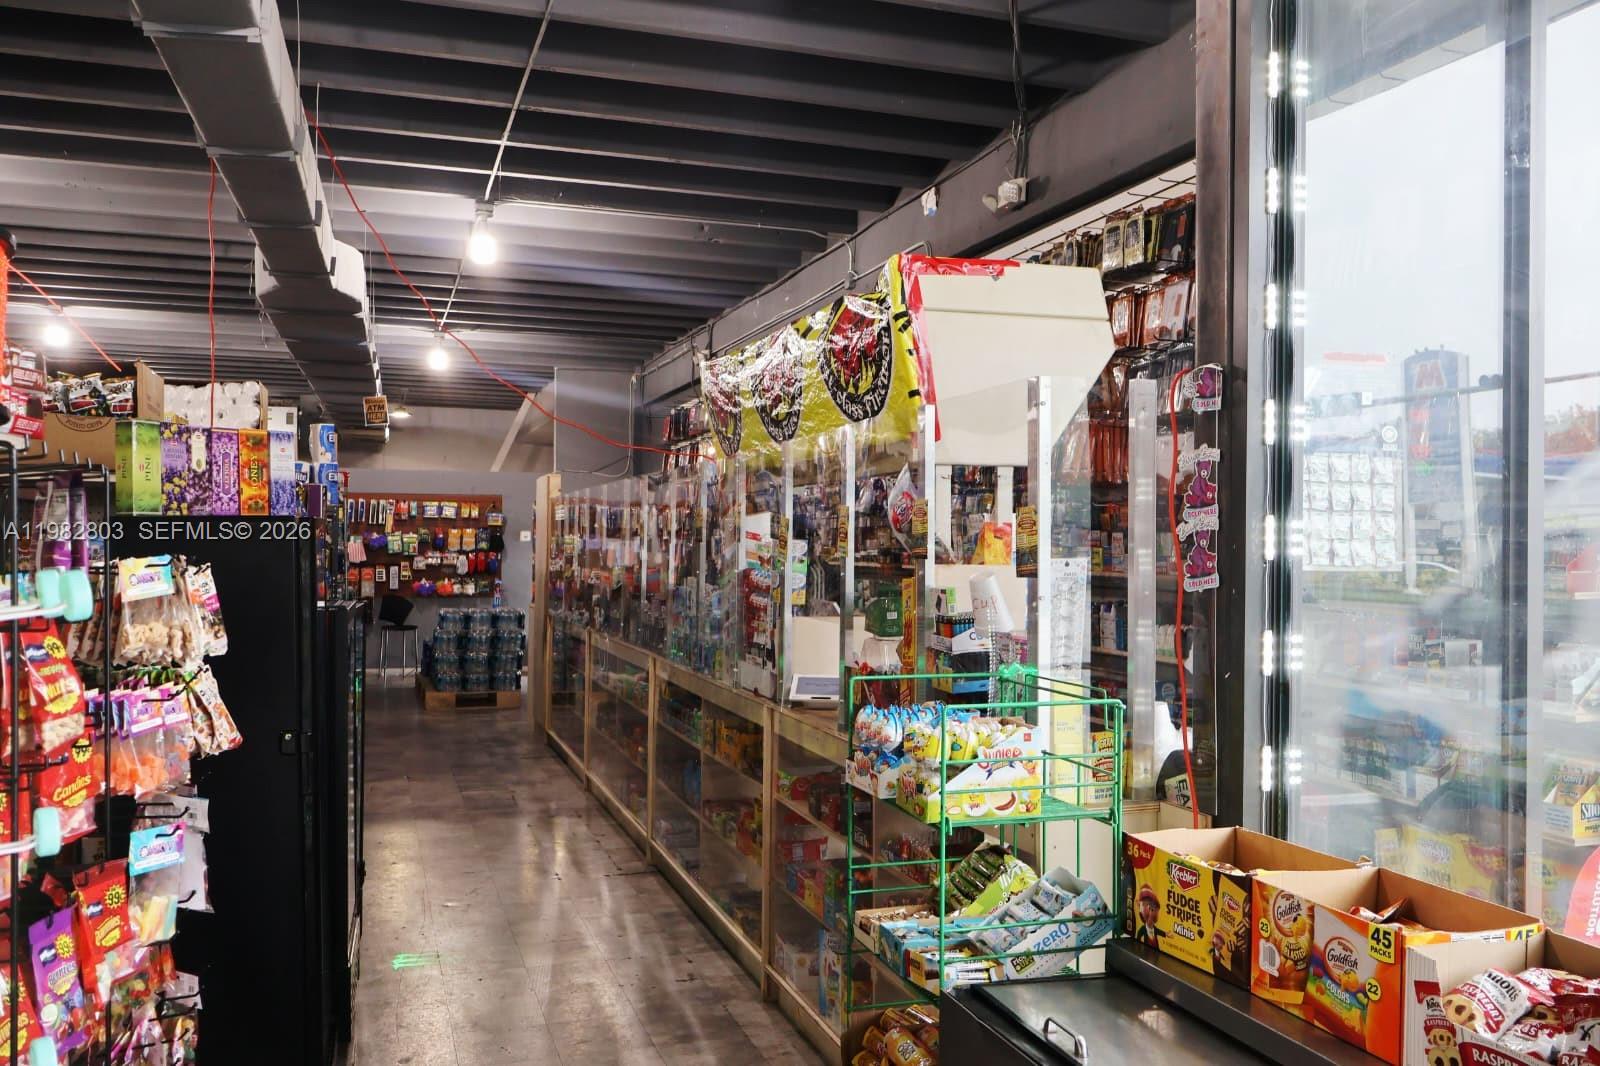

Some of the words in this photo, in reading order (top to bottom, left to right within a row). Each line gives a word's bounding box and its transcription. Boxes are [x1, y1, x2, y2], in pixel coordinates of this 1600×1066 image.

[53, 774, 91, 802] Candies
[1127, 841, 1139, 856] 36
[1139, 850, 1151, 859] Pack
[1170, 863, 1197, 885] Keebler
[1167, 889, 1201, 913] FUDGE
[1276, 901, 1303, 921] Goldfish
[1166, 903, 1202, 927] STRIPES
[1173, 922, 1195, 941] Minis
[1260, 921, 1269, 933] 23
[1370, 927, 1392, 950] 45
[1328, 947, 1359, 970] Goldfish
[1370, 945, 1392, 959] PACKS
[1326, 980, 1350, 1004] COLORS
[1367, 983, 1378, 996] 22
